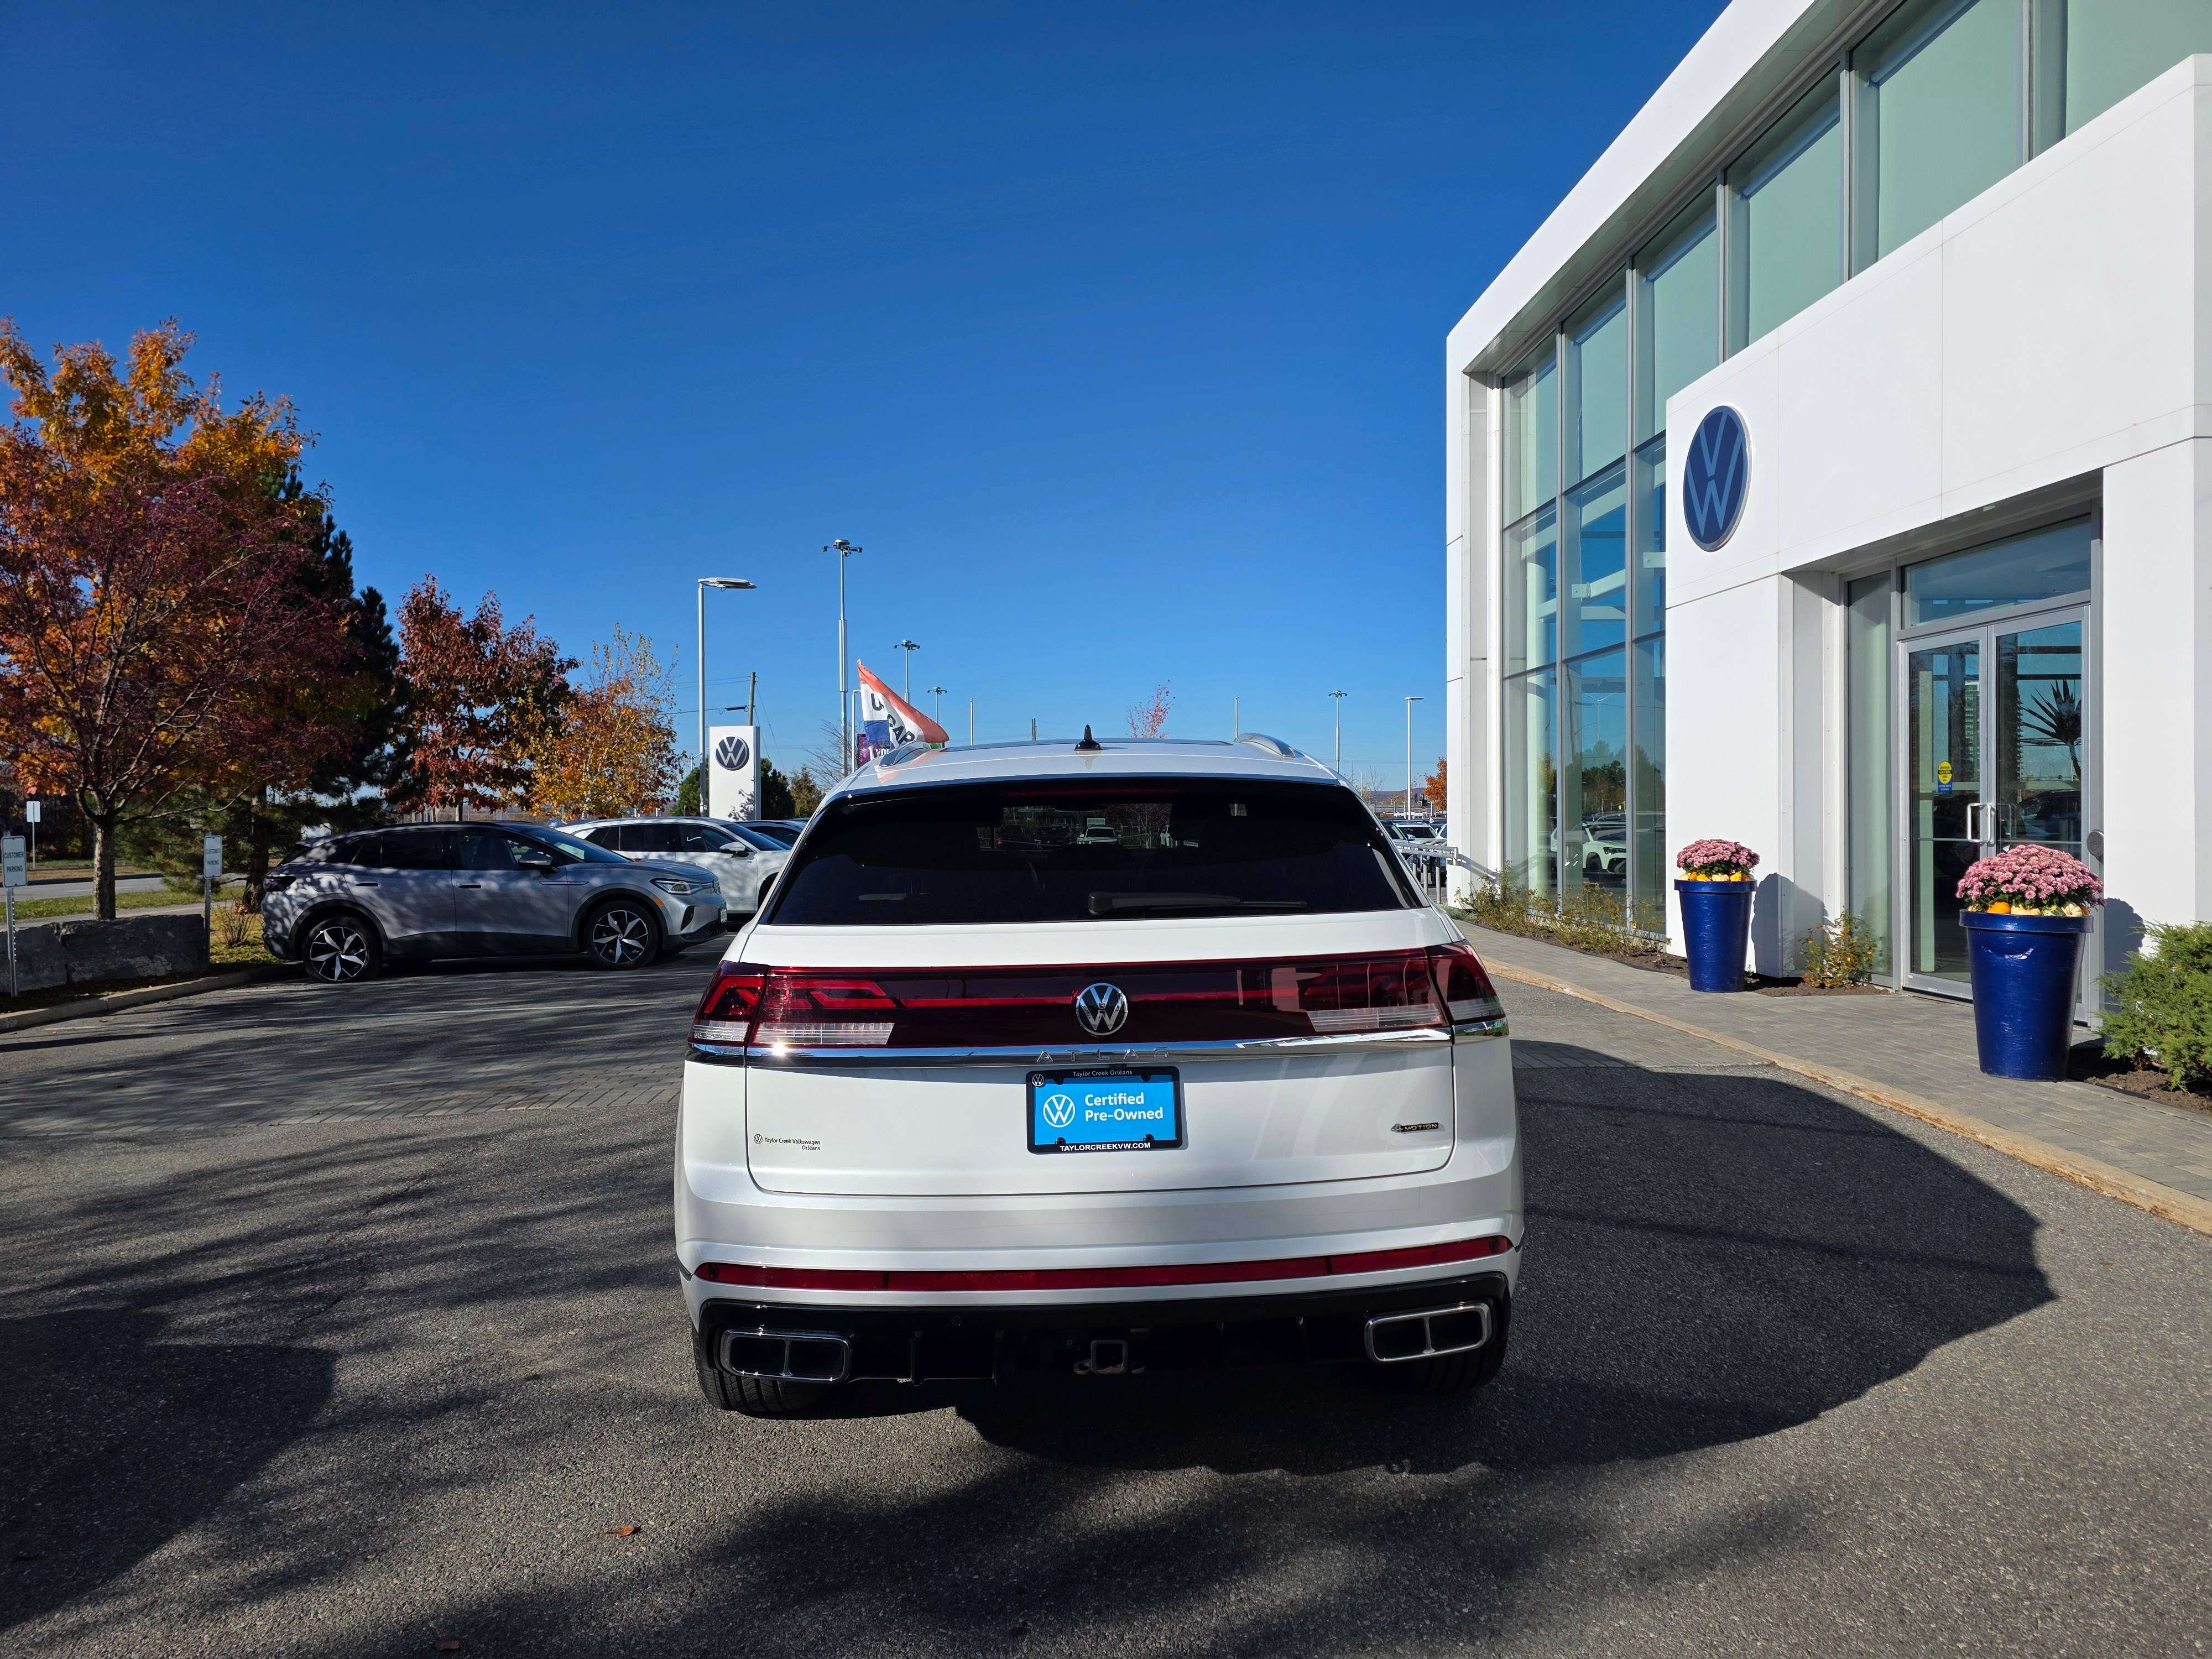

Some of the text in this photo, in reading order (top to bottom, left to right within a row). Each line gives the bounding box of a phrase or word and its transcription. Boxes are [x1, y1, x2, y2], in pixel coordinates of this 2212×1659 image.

[1684, 406, 1748, 551] VW
[716, 735, 748, 770] VW
[1076, 983, 1128, 1035] VW
[1037, 1047, 1169, 1062] ATLAS
[1043, 1094, 1076, 1128] VW
[1085, 1092, 1144, 1106] Certified
[1085, 1107, 1164, 1121] Pre-Owned
[1060, 1142, 1151, 1151] TAYLORCREEKVW.COM
